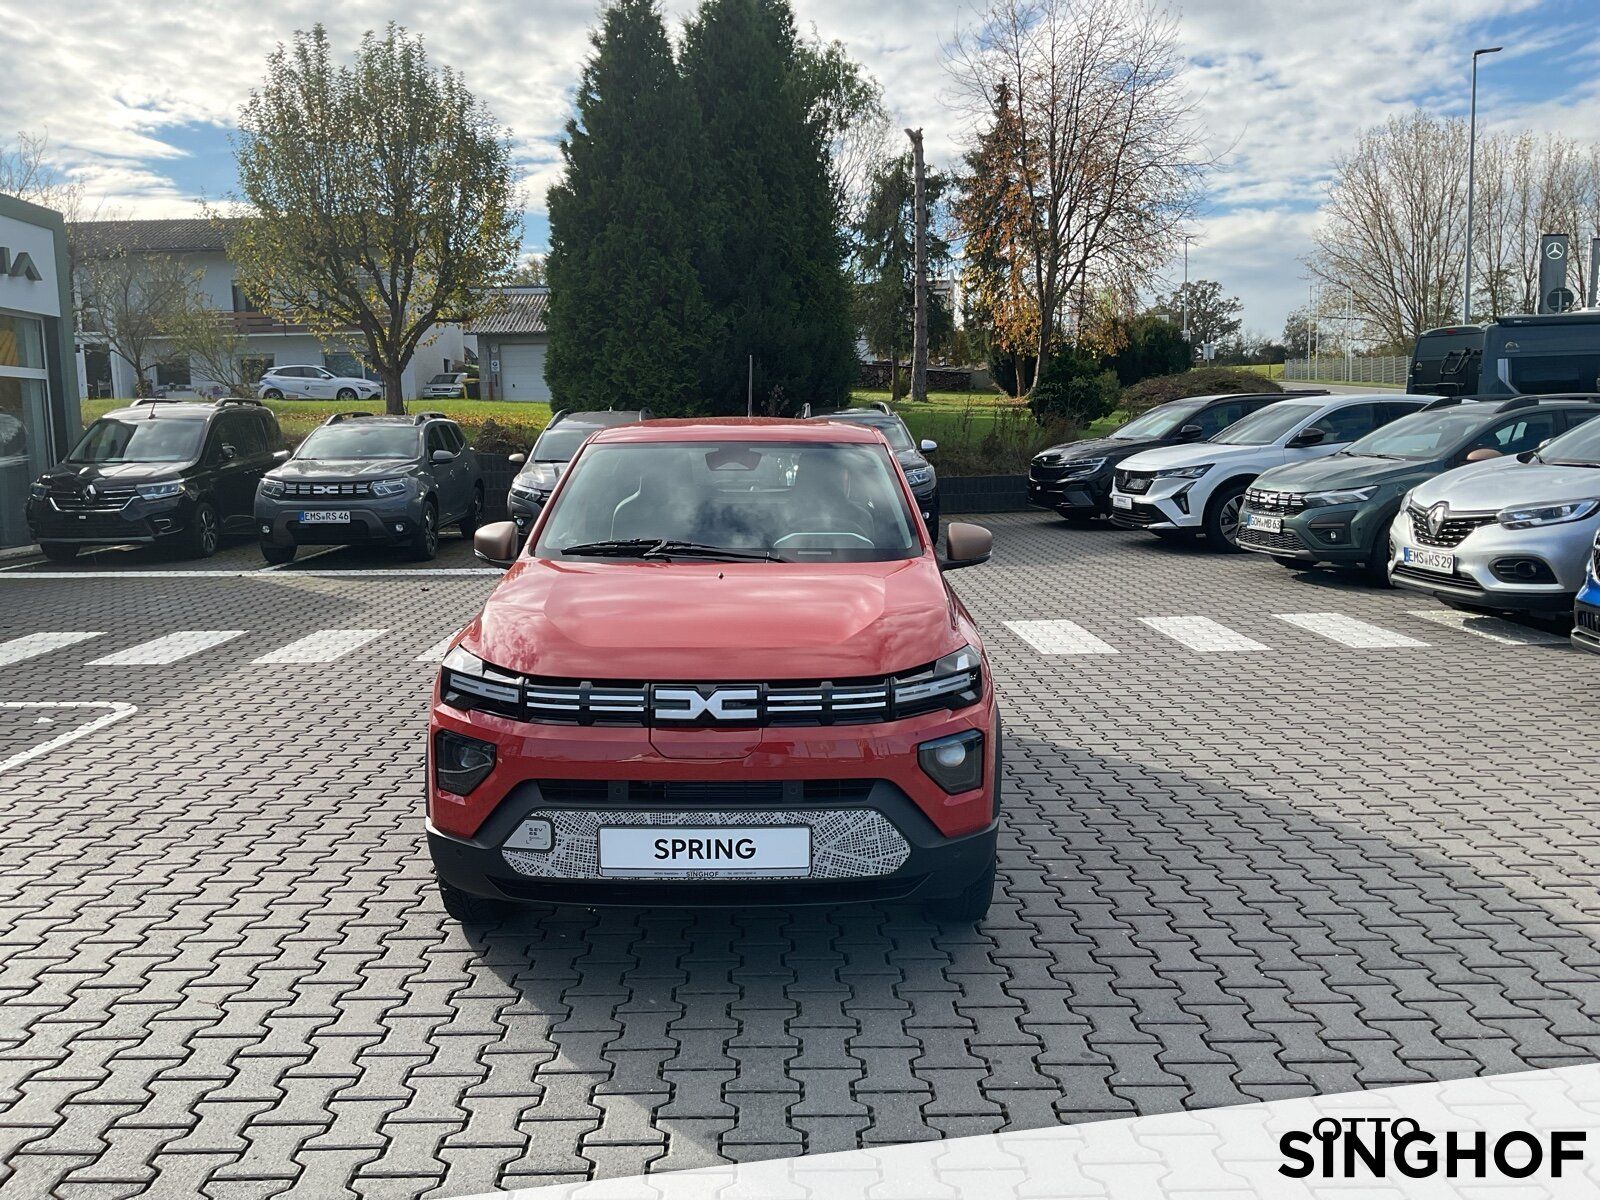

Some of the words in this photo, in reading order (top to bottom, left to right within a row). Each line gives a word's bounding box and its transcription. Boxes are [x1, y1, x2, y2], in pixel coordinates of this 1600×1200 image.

[338, 512, 349, 520] 46
[1441, 556, 1453, 569] 29
[653, 838, 757, 860] SPRING
